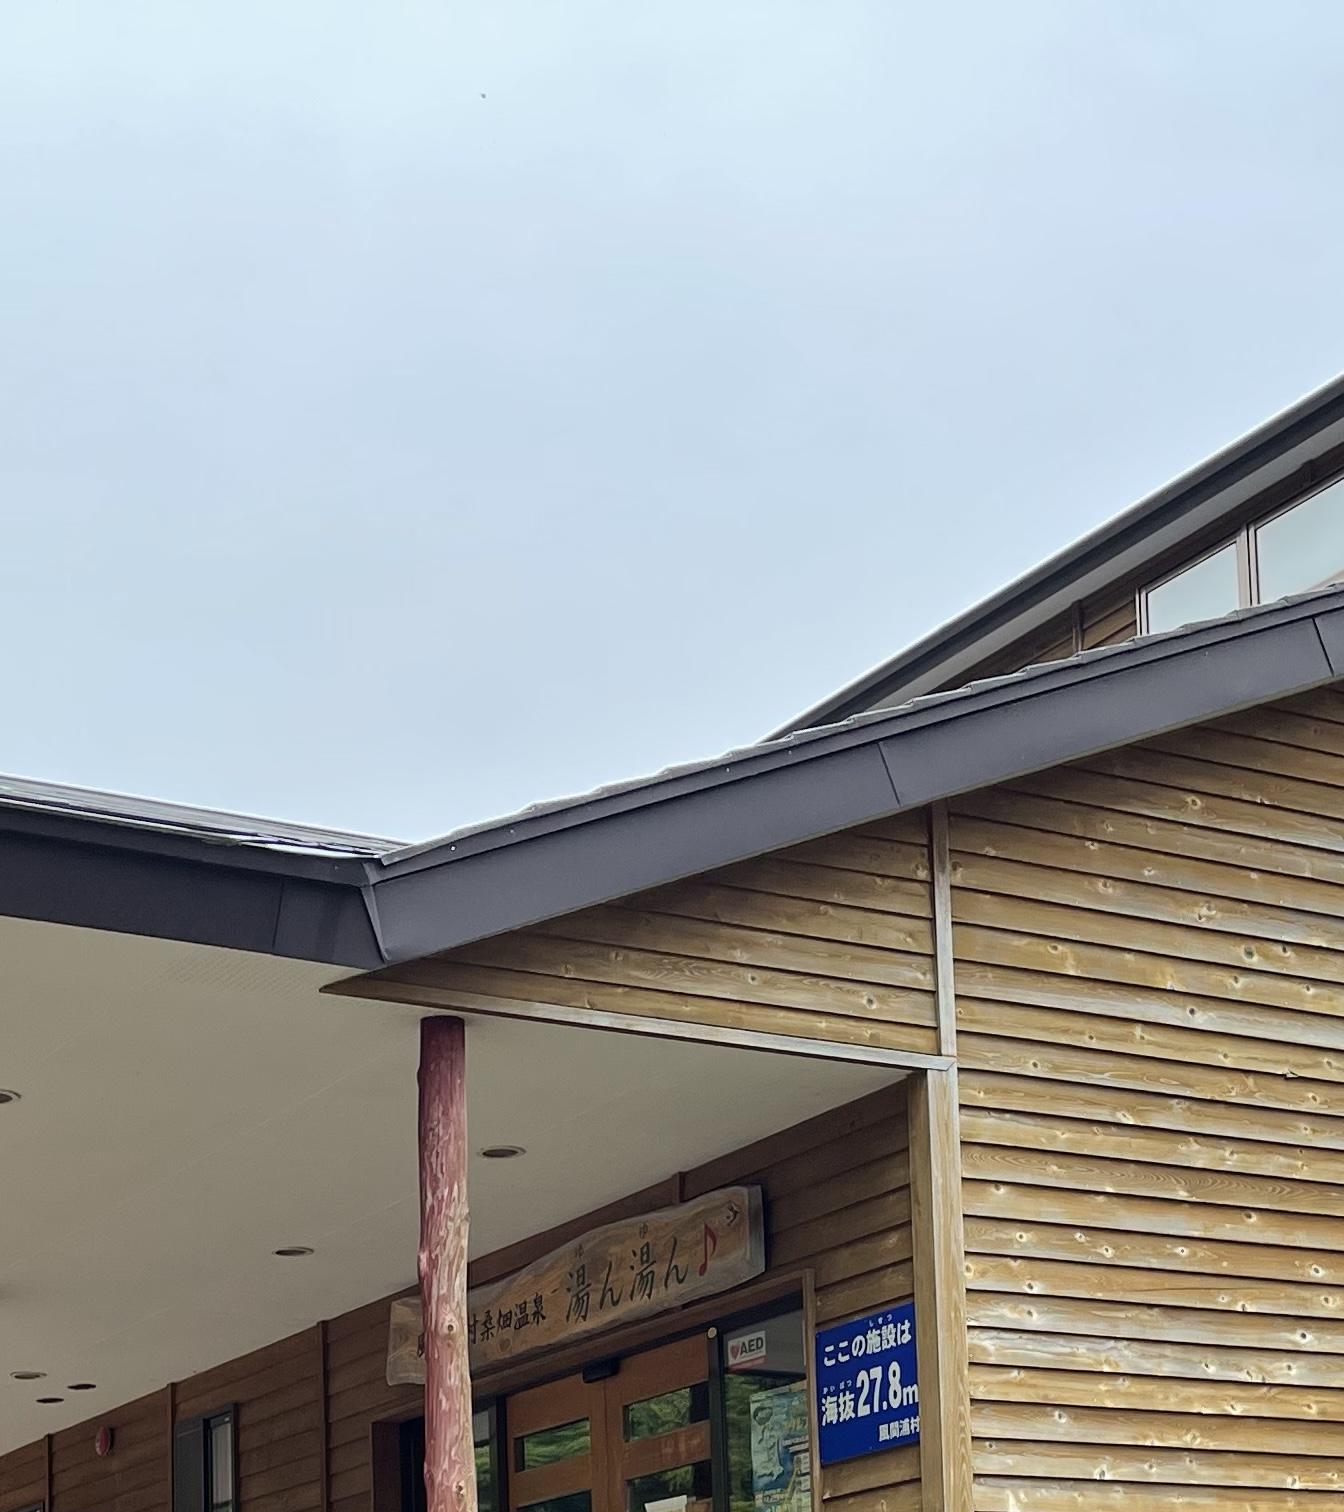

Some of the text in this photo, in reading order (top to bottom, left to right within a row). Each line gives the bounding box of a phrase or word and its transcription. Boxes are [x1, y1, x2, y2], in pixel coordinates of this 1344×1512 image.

[739, 1336, 764, 1356] AED
[823, 1319, 912, 1367] ここの施設は
